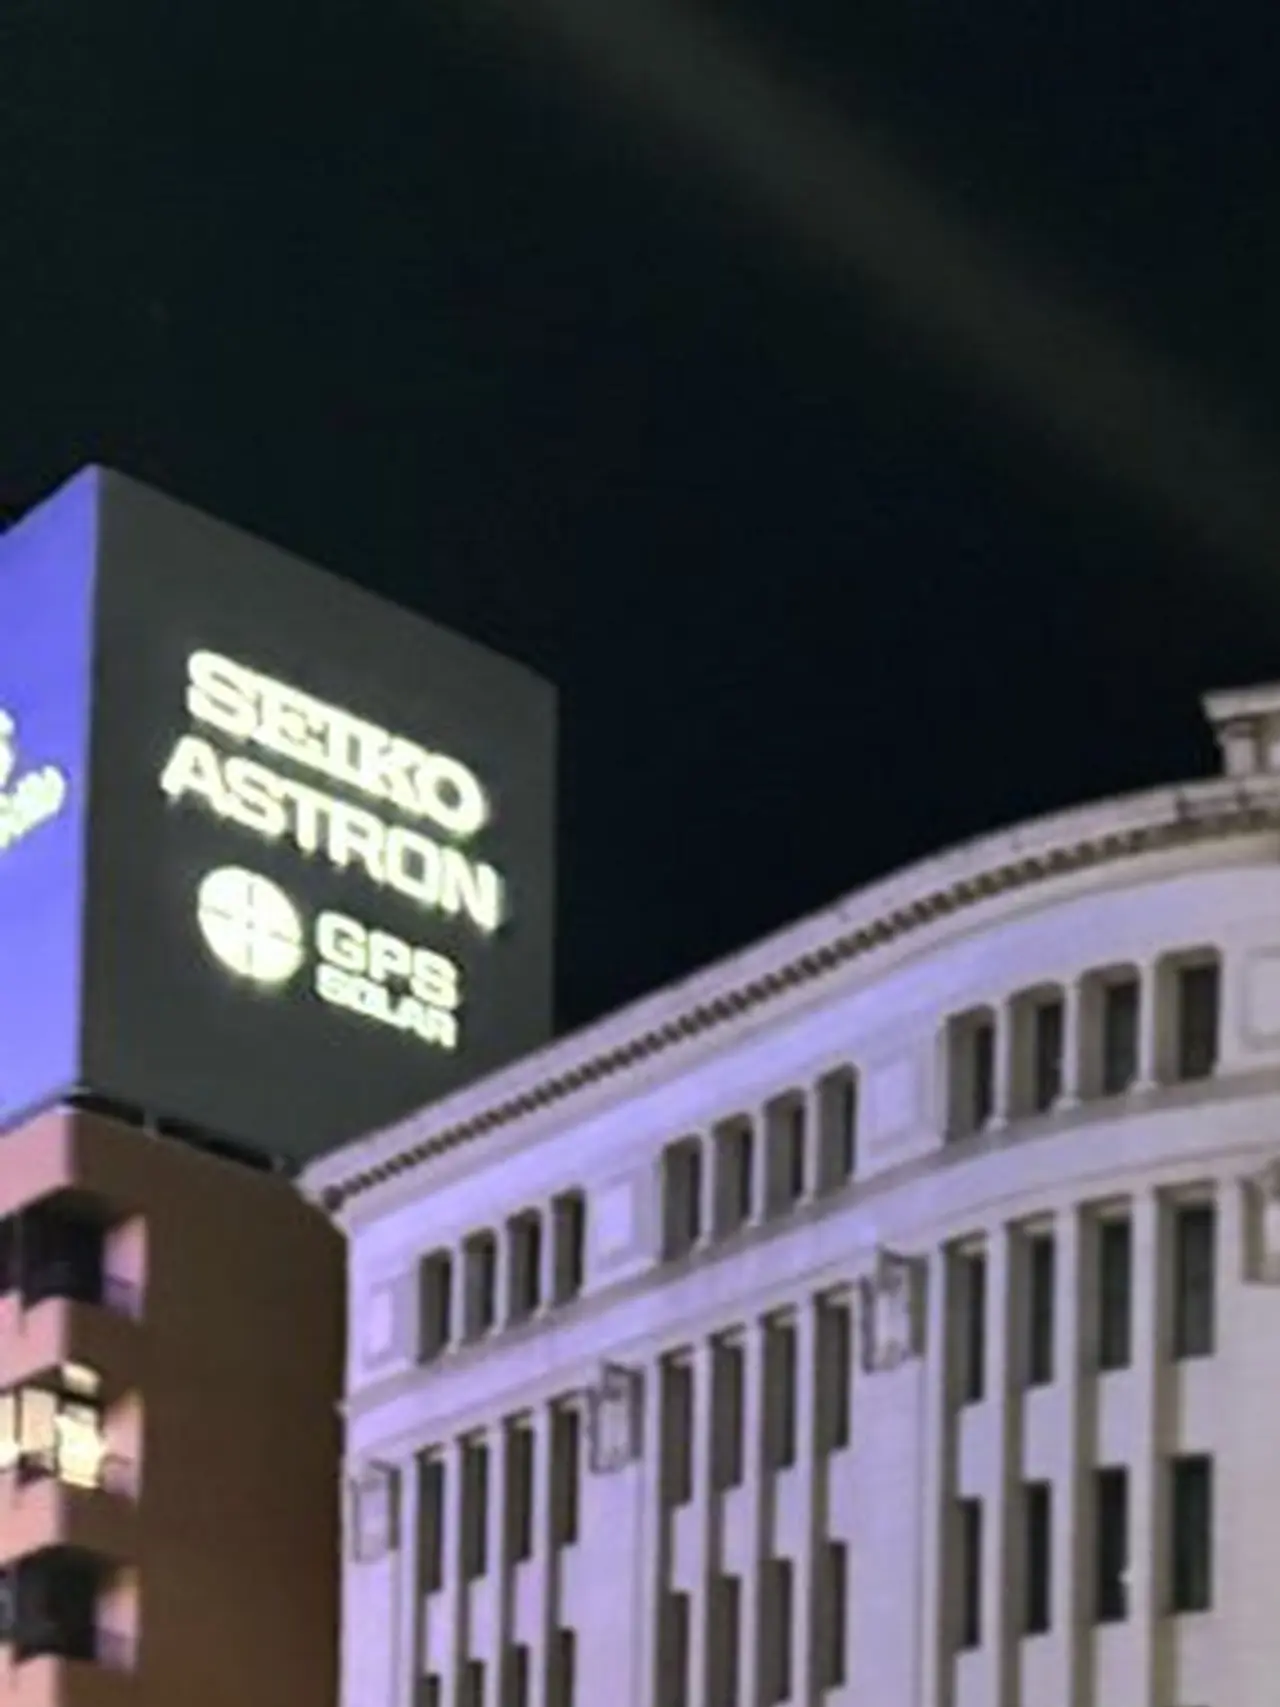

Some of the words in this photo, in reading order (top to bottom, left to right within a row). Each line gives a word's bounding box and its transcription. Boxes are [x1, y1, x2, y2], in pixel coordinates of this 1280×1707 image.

[187, 649, 490, 836] SEIKO
[160, 734, 504, 934] ASTRON
[315, 909, 459, 1010] GPS
[315, 962, 458, 1049] SOLAR
